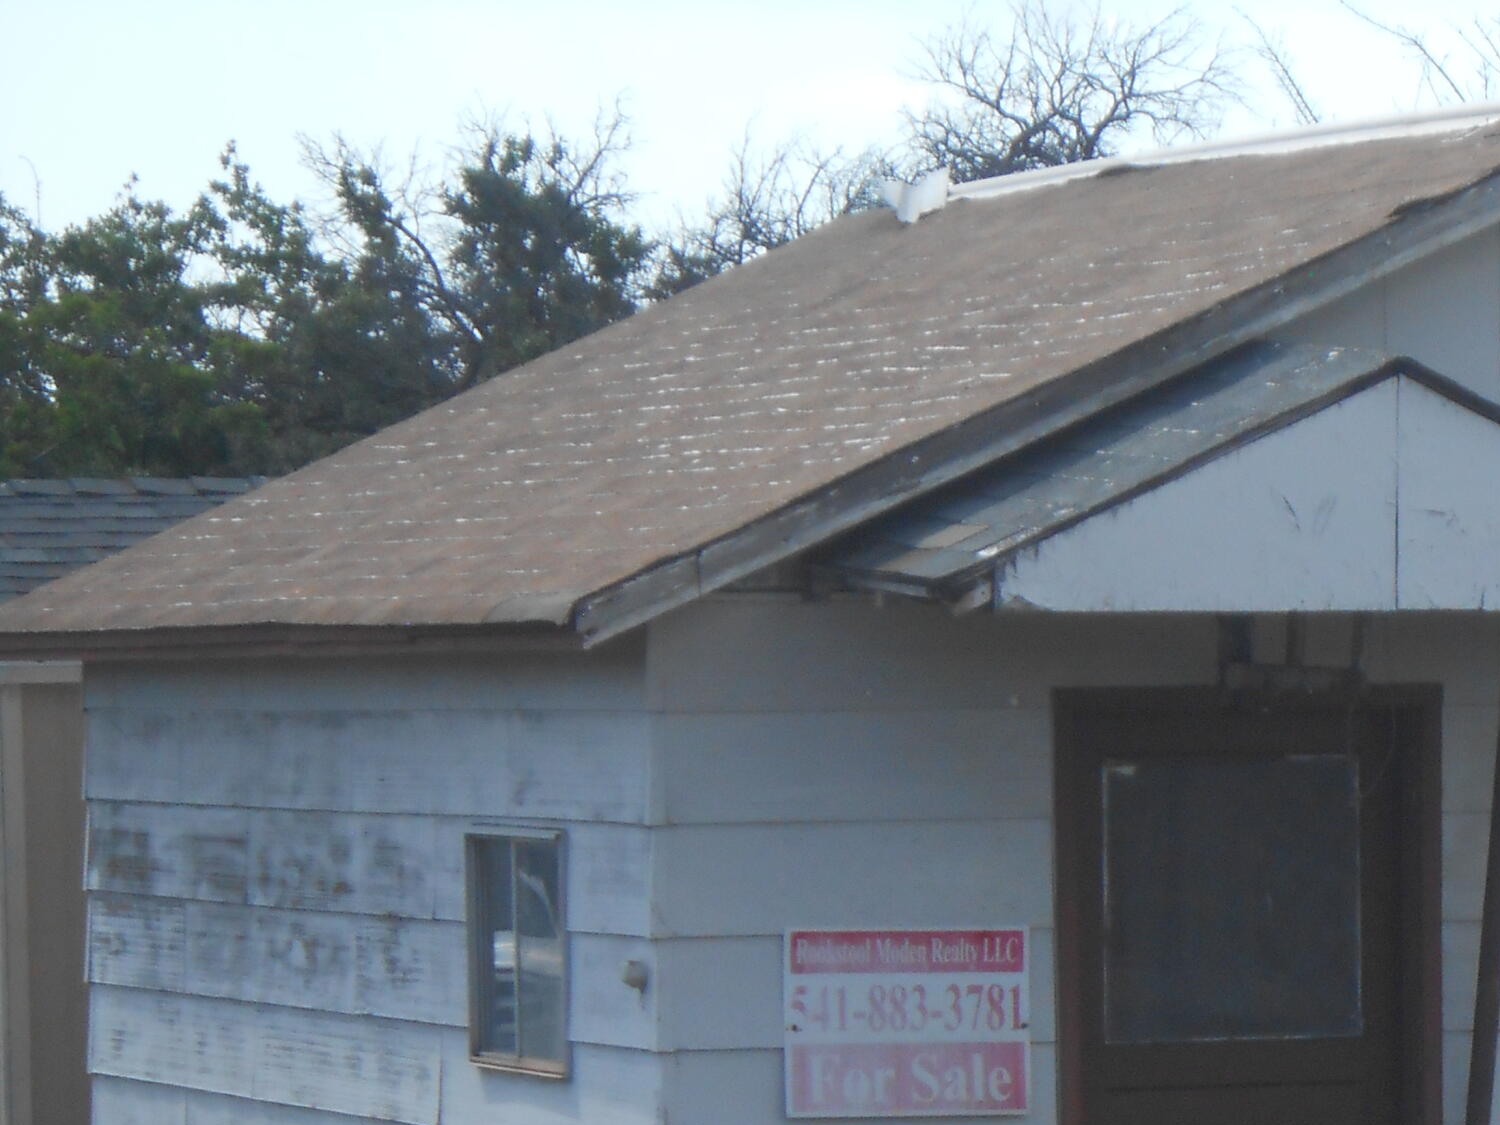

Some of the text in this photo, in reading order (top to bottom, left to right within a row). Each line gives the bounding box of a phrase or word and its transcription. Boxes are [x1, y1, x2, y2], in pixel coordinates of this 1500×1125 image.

[931, 937, 978, 971] Realty
[983, 937, 1019, 963] LLC
[791, 984, 1022, 1032] 541-883-3781
[809, 1052, 1013, 1105] For Sale
